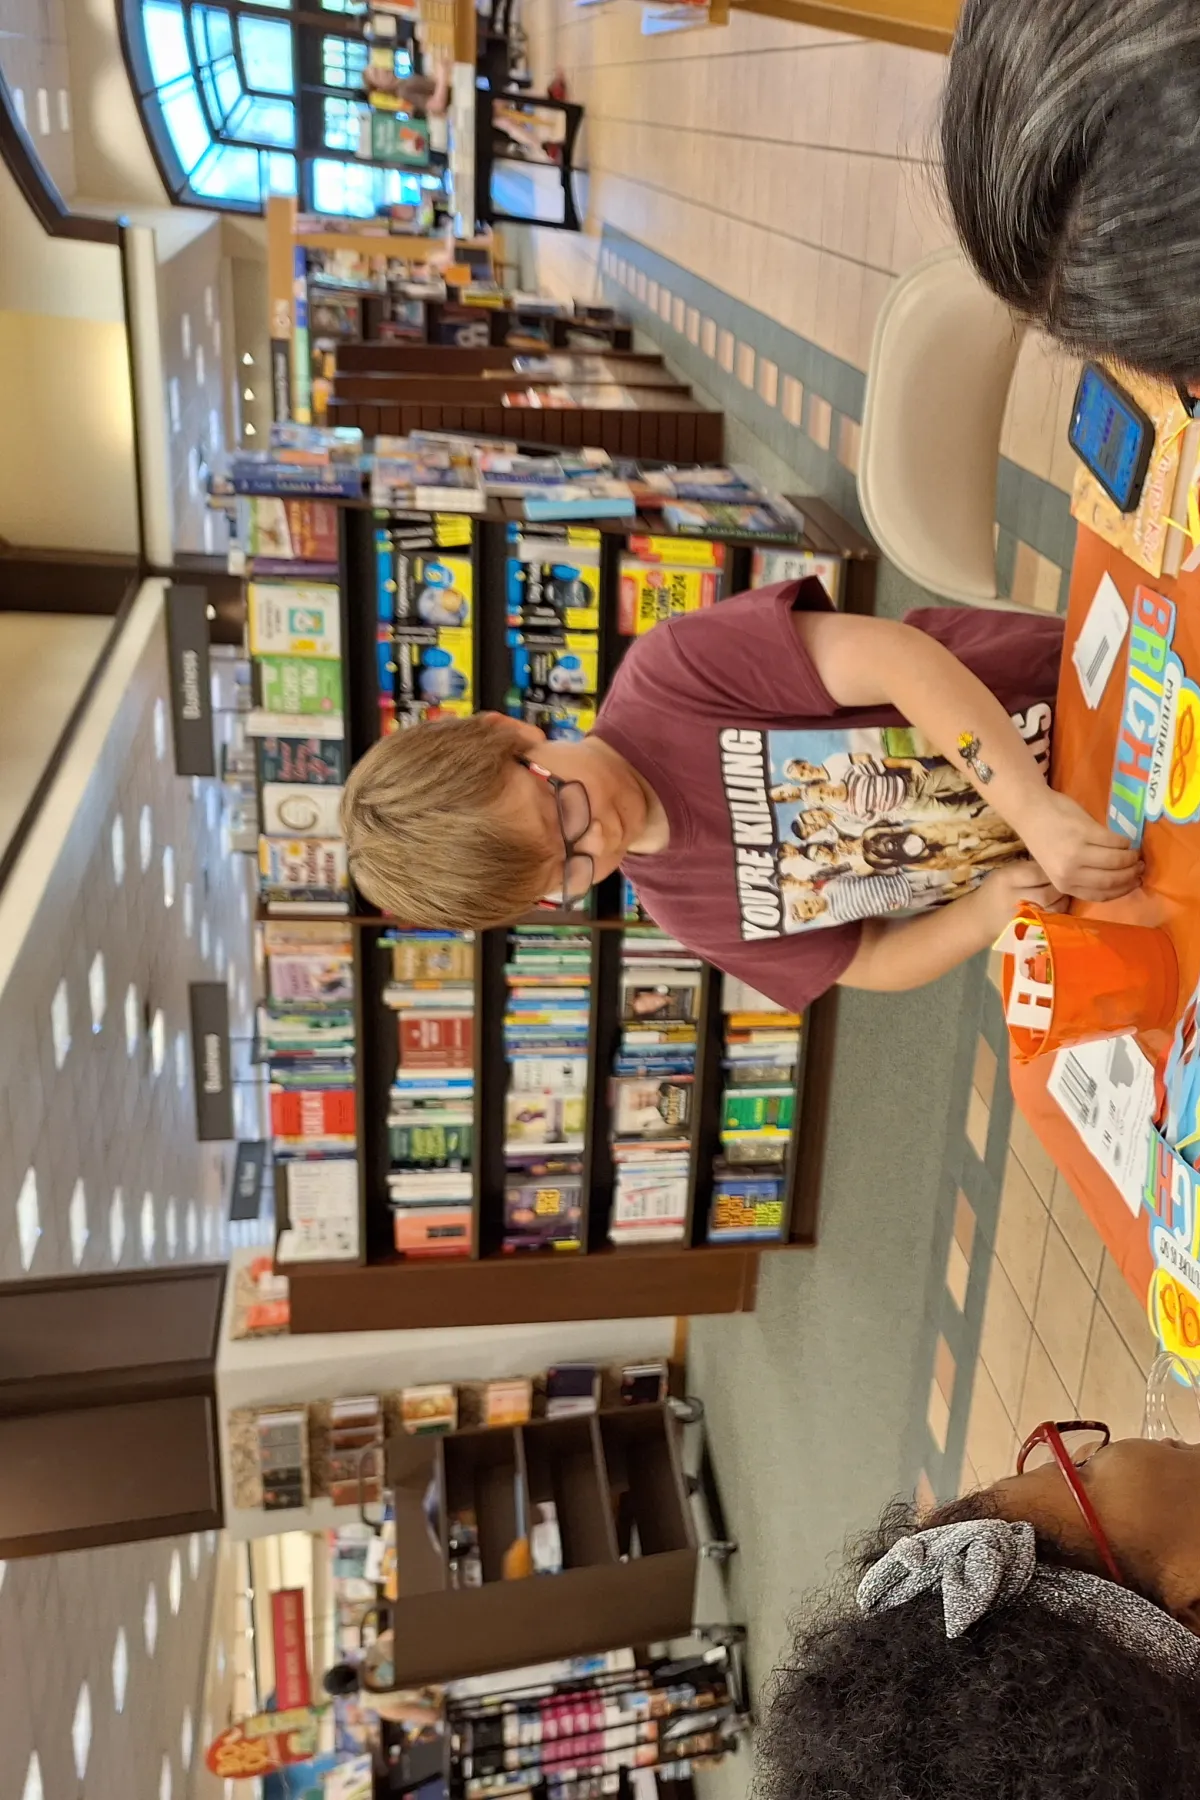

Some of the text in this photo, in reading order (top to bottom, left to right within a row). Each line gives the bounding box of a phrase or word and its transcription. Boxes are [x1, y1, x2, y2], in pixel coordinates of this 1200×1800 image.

[180, 649, 201, 719] Business
[1109, 589, 1171, 840] BRIGHT!
[1164, 678, 1174, 704] MY
[1156, 704, 1170, 761] FUTURE
[718, 727, 780, 940] YOU'RE KILLING
[203, 1033, 222, 1093] Business
